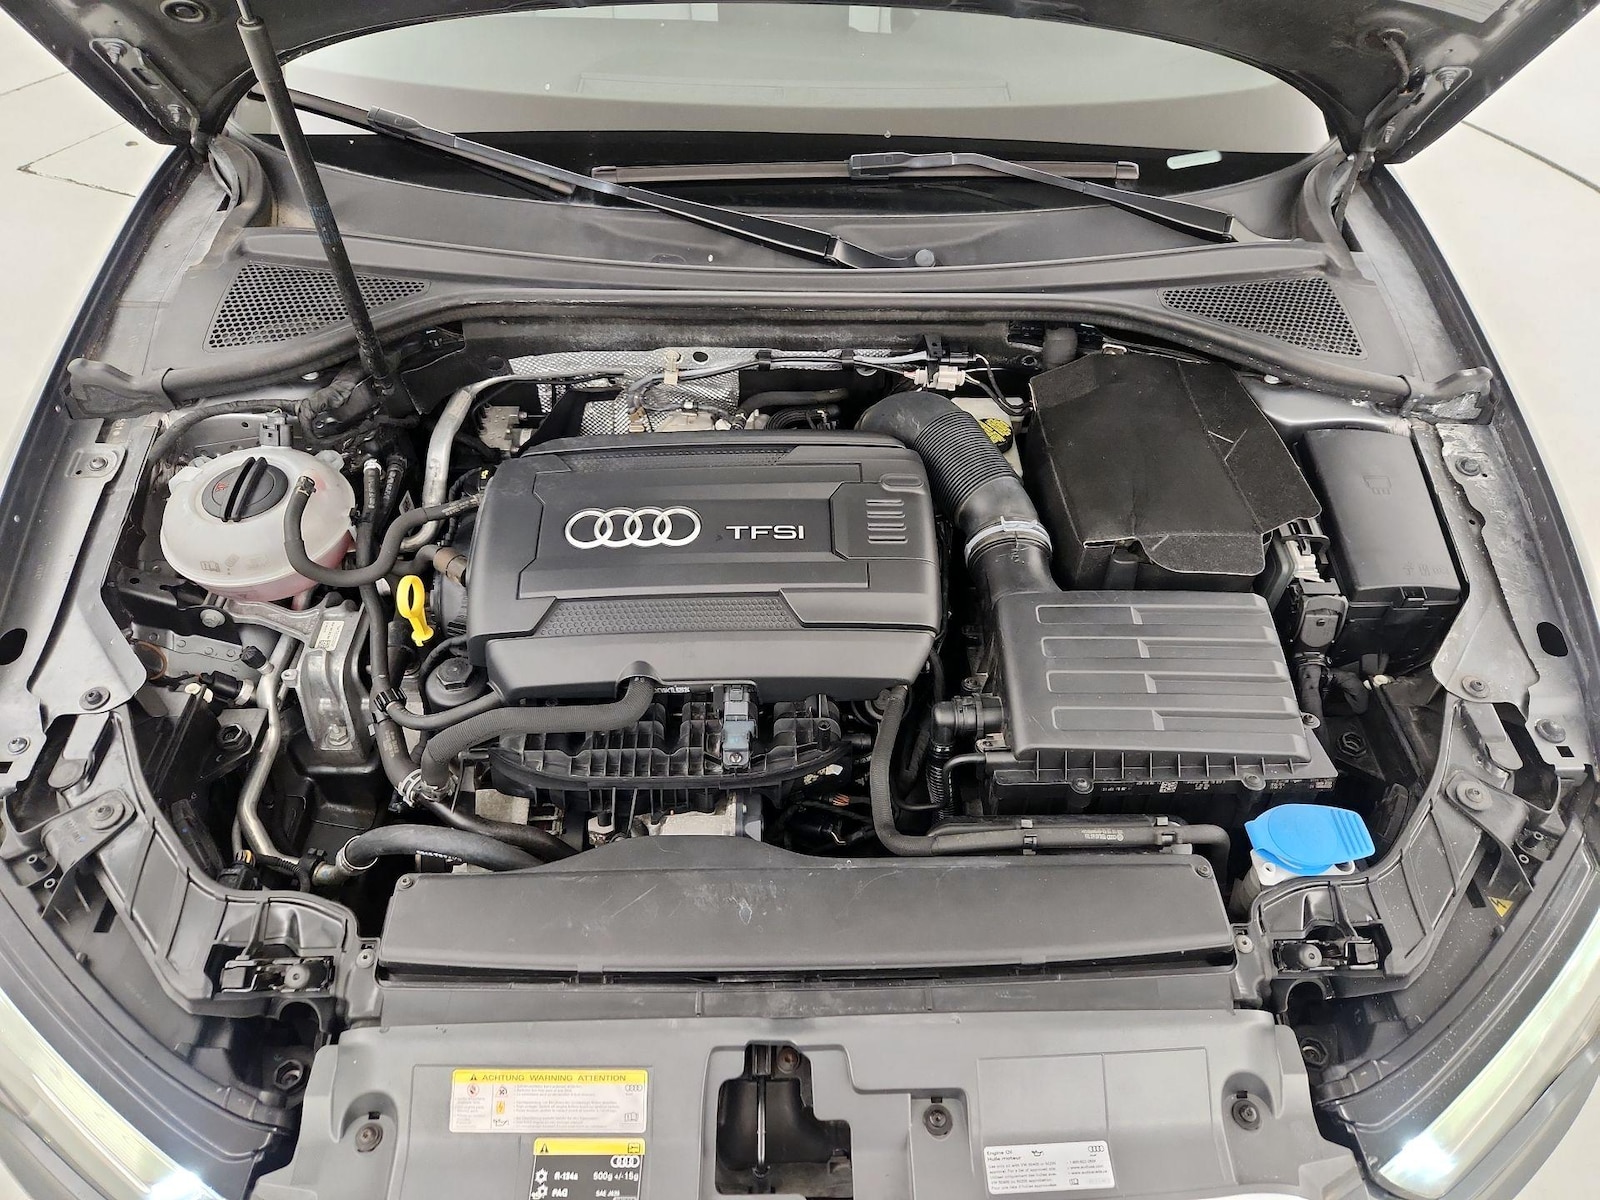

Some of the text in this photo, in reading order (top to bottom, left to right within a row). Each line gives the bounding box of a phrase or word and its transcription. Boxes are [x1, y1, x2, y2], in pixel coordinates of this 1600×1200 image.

[726, 525, 807, 541] TFSI
[482, 1073, 628, 1083] ACHTUNG WARNING ATTENTION
